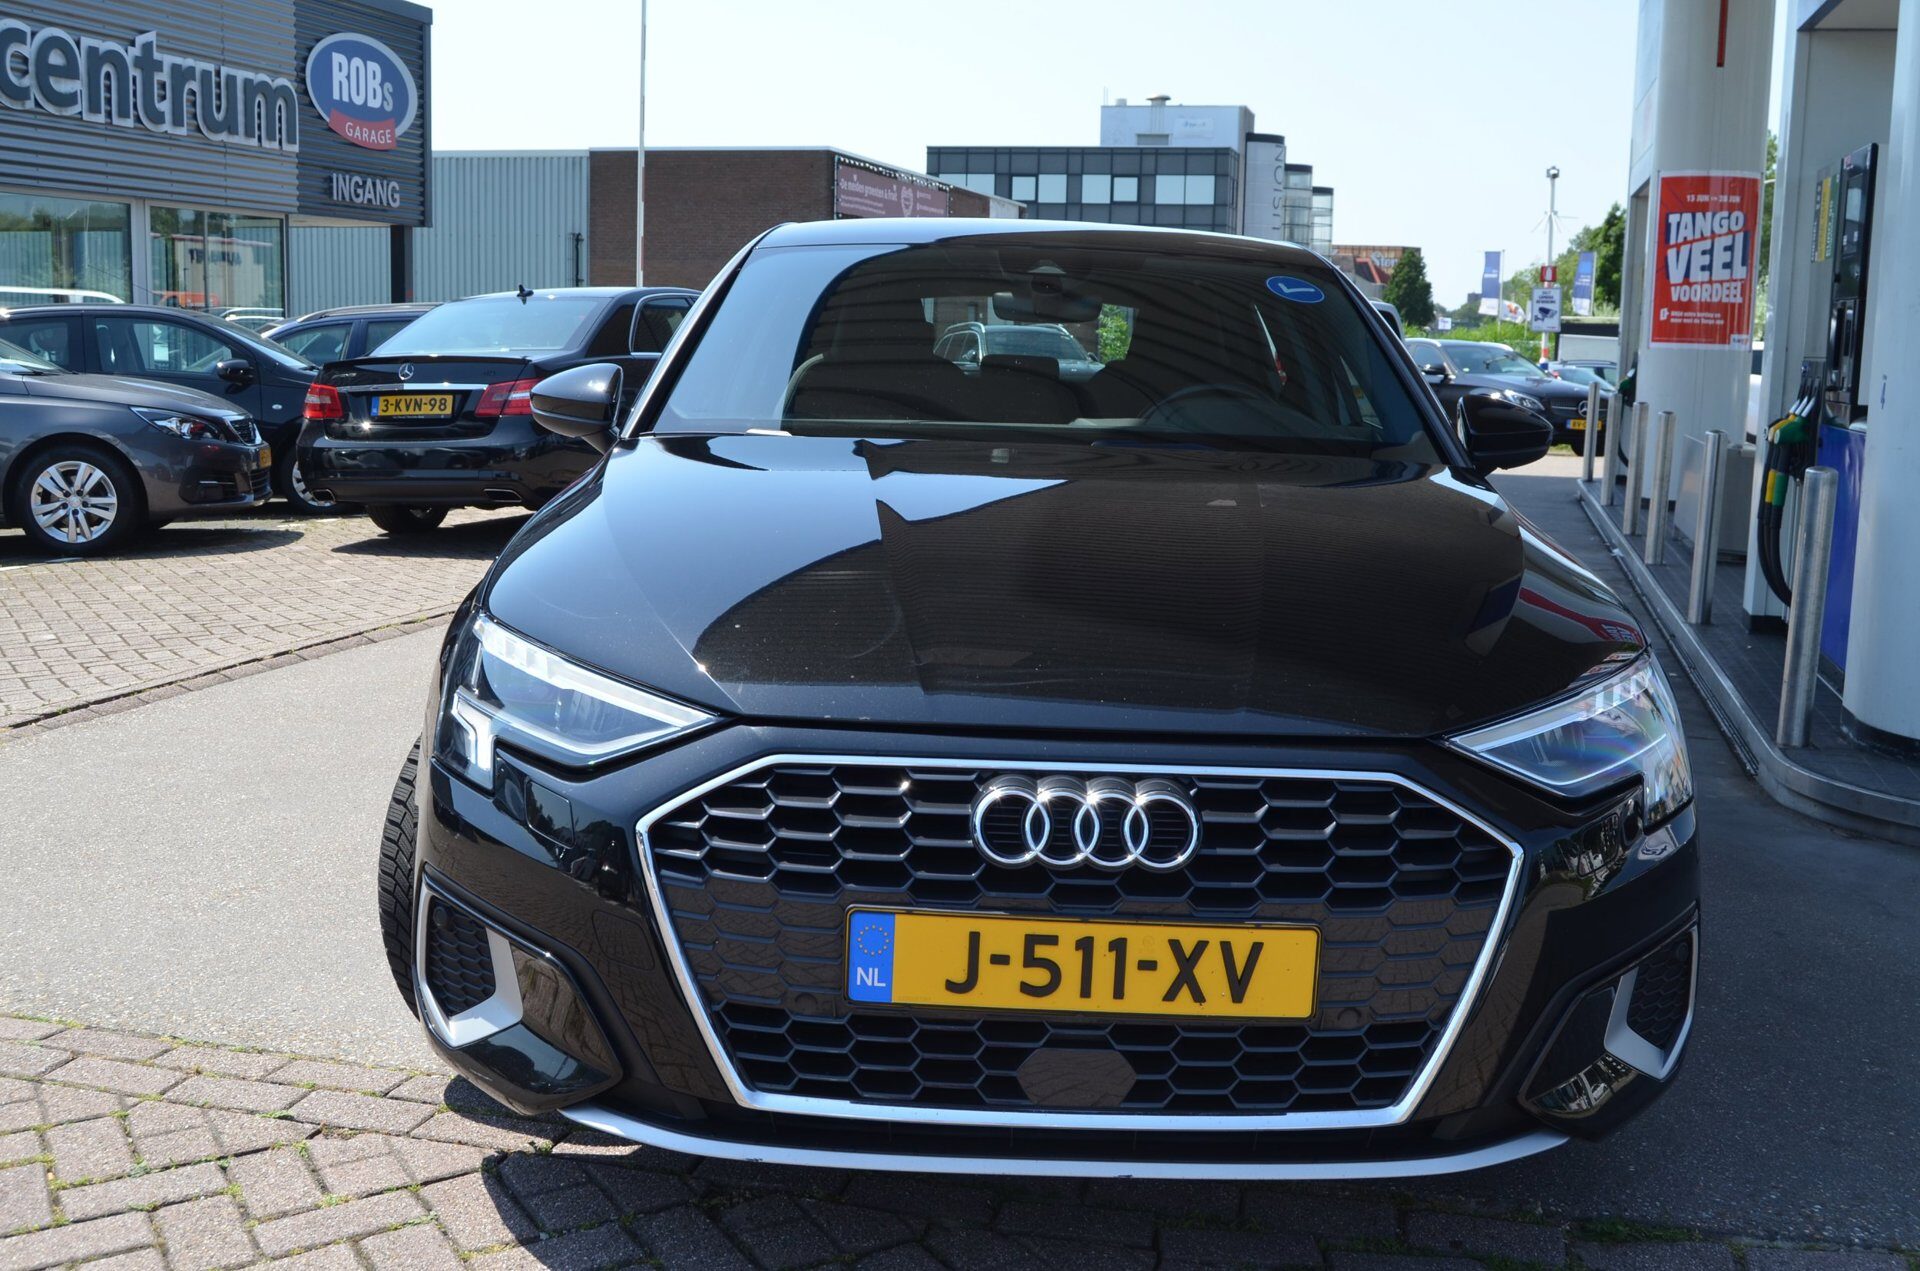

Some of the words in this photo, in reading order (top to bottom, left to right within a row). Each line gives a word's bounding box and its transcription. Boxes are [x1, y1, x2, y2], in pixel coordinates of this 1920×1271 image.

[0, 20, 298, 151] centrum
[345, 122, 393, 144] GARAGE
[331, 172, 400, 208] INGANG
[1668, 210, 1745, 246] TANGO
[1667, 231, 1748, 285] VEEL
[1671, 281, 1744, 303] VOORDEEL
[381, 397, 448, 413] 3-KVN-98
[856, 966, 887, 987] NL
[944, 930, 1264, 1004] J-511-XV
